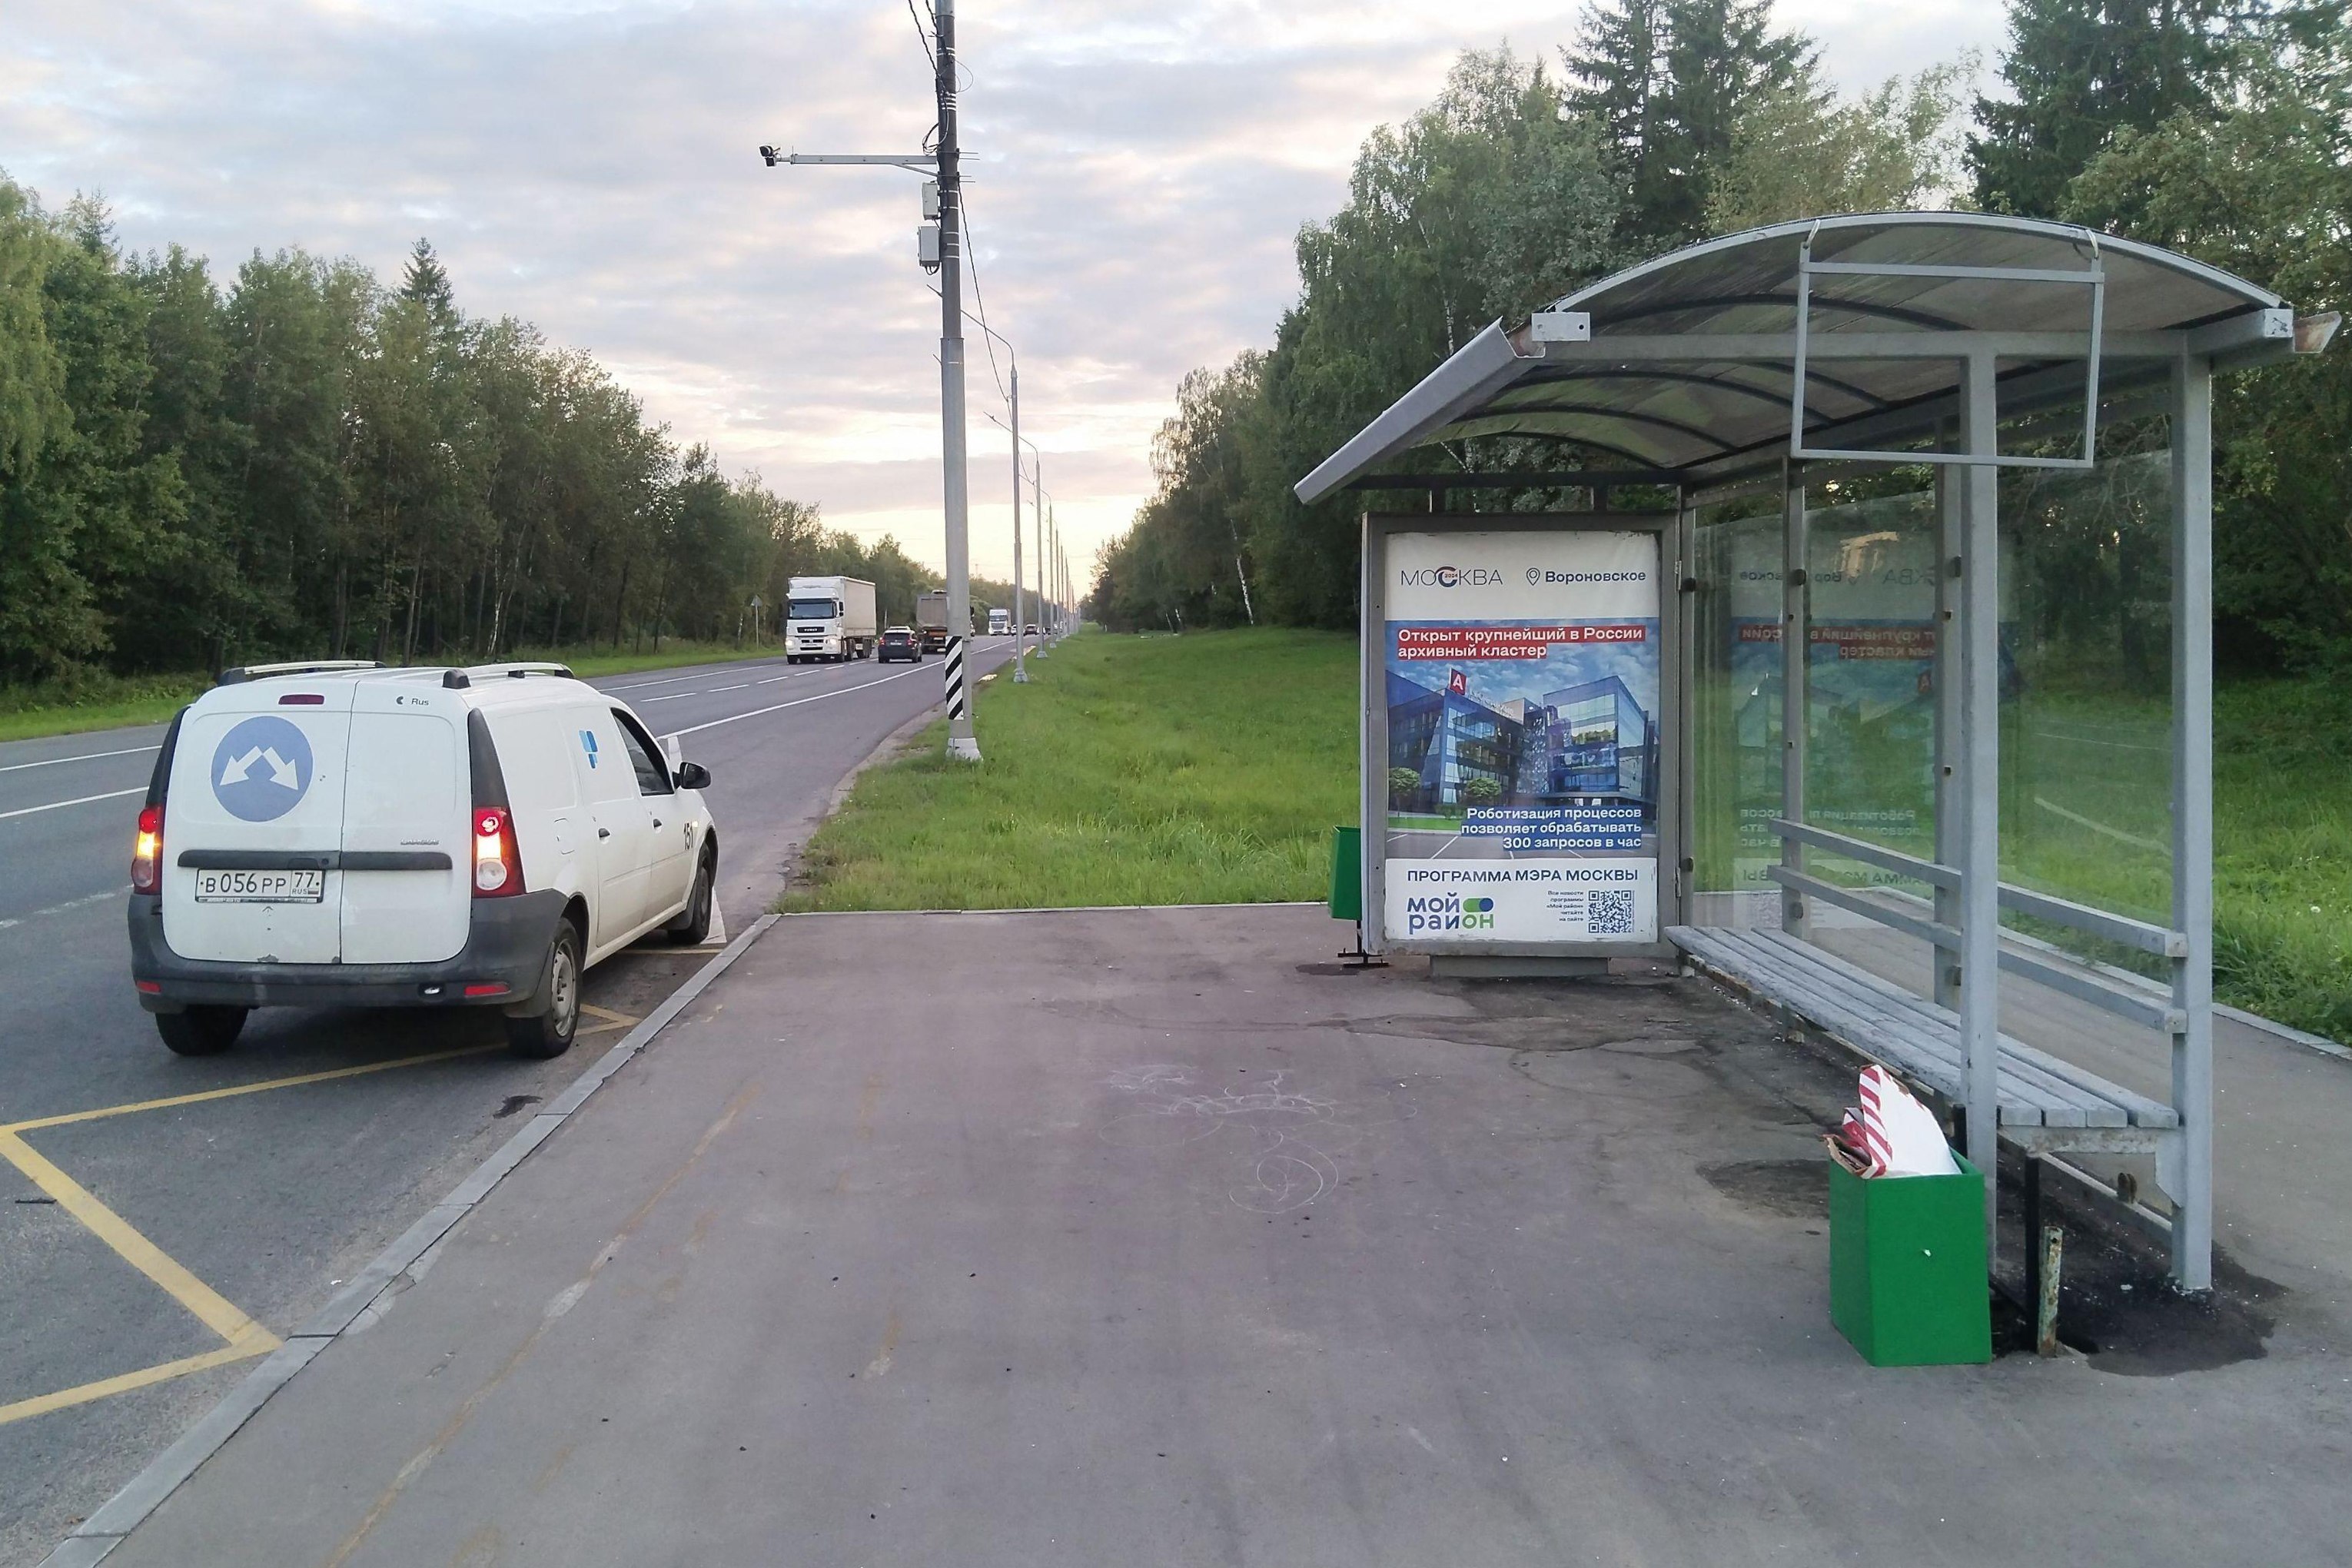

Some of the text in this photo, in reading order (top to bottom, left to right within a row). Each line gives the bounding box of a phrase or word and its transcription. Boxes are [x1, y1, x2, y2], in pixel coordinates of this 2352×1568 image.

[1400, 566, 1503, 587] МОСКВА
[1545, 570, 1646, 584] Вороновское
[1398, 626, 1643, 643] Открыт крупнейший в России
[1398, 644, 1547, 659] архивный кластер
[1467, 808, 1642, 821] Роботизация процессов
[1461, 822, 1642, 835] позволяет обрабатывать
[1503, 837, 1642, 850] 300 запросов в час
[294, 872, 315, 889] 77
[1407, 869, 1638, 882] ПРОГРАММА МЭРА МОСКВЫ
[1407, 892, 1460, 913] мой
